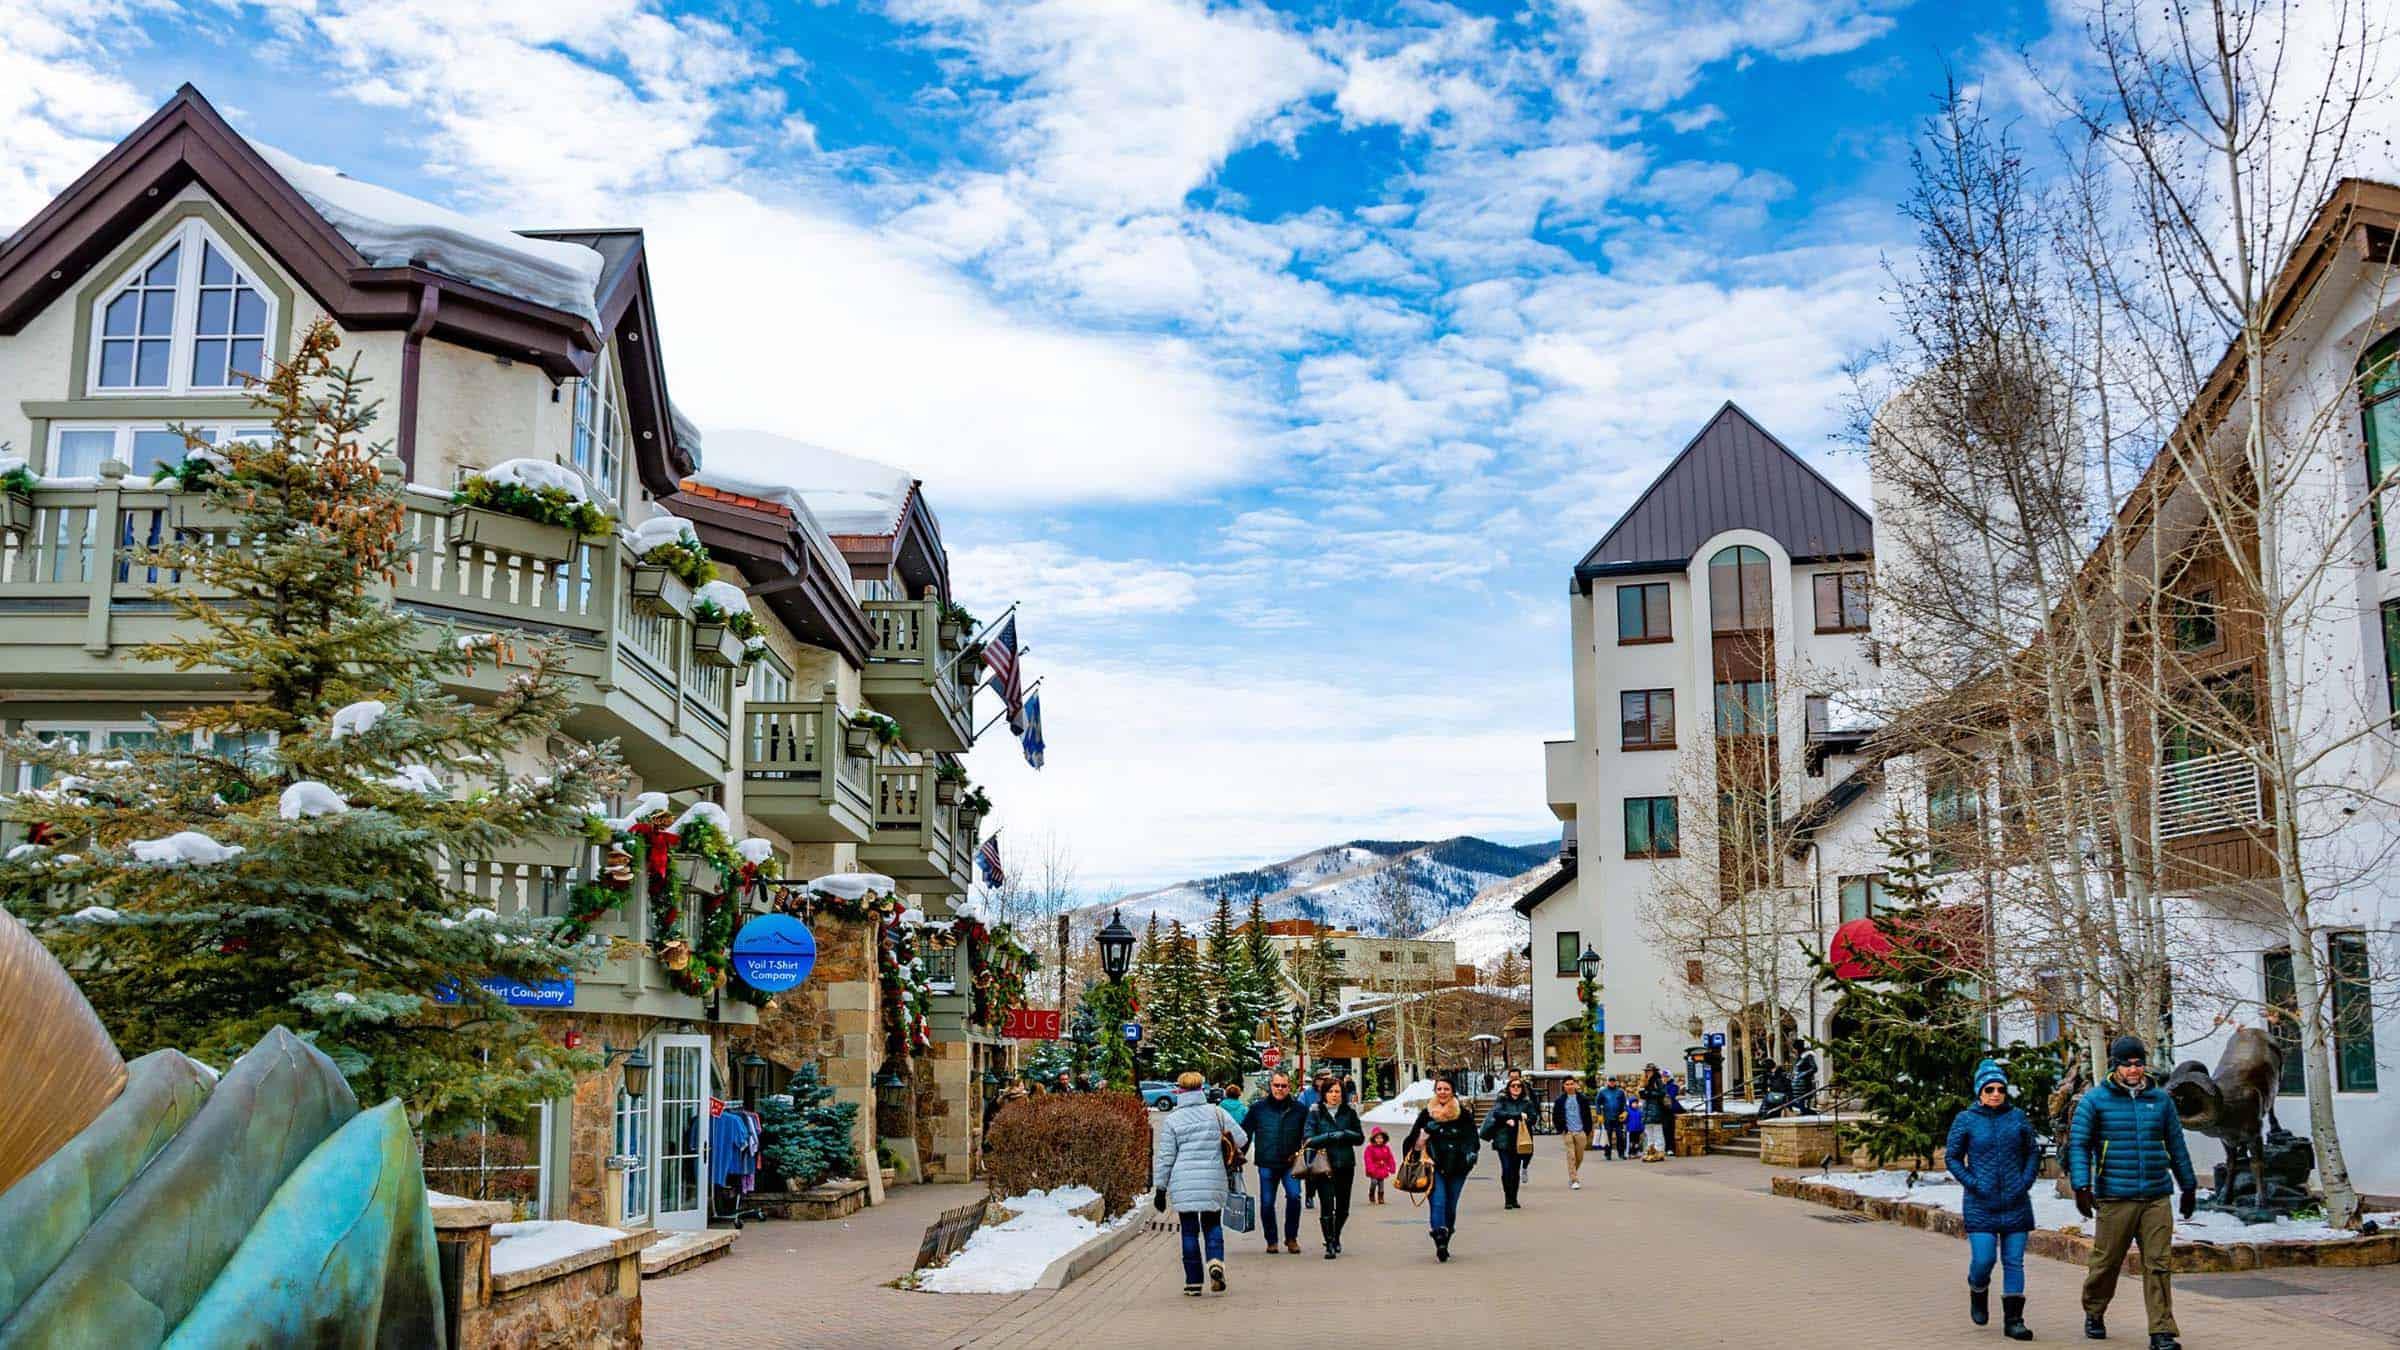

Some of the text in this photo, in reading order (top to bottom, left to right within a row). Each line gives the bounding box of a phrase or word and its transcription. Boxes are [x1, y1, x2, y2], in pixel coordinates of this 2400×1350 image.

[748, 959, 799, 969] Vail T-Shirt
[751, 970, 797, 982] Company
[479, 984, 508, 996] Shirt
[511, 985, 565, 1001] Company
[1263, 1054, 1280, 1063] STOP
